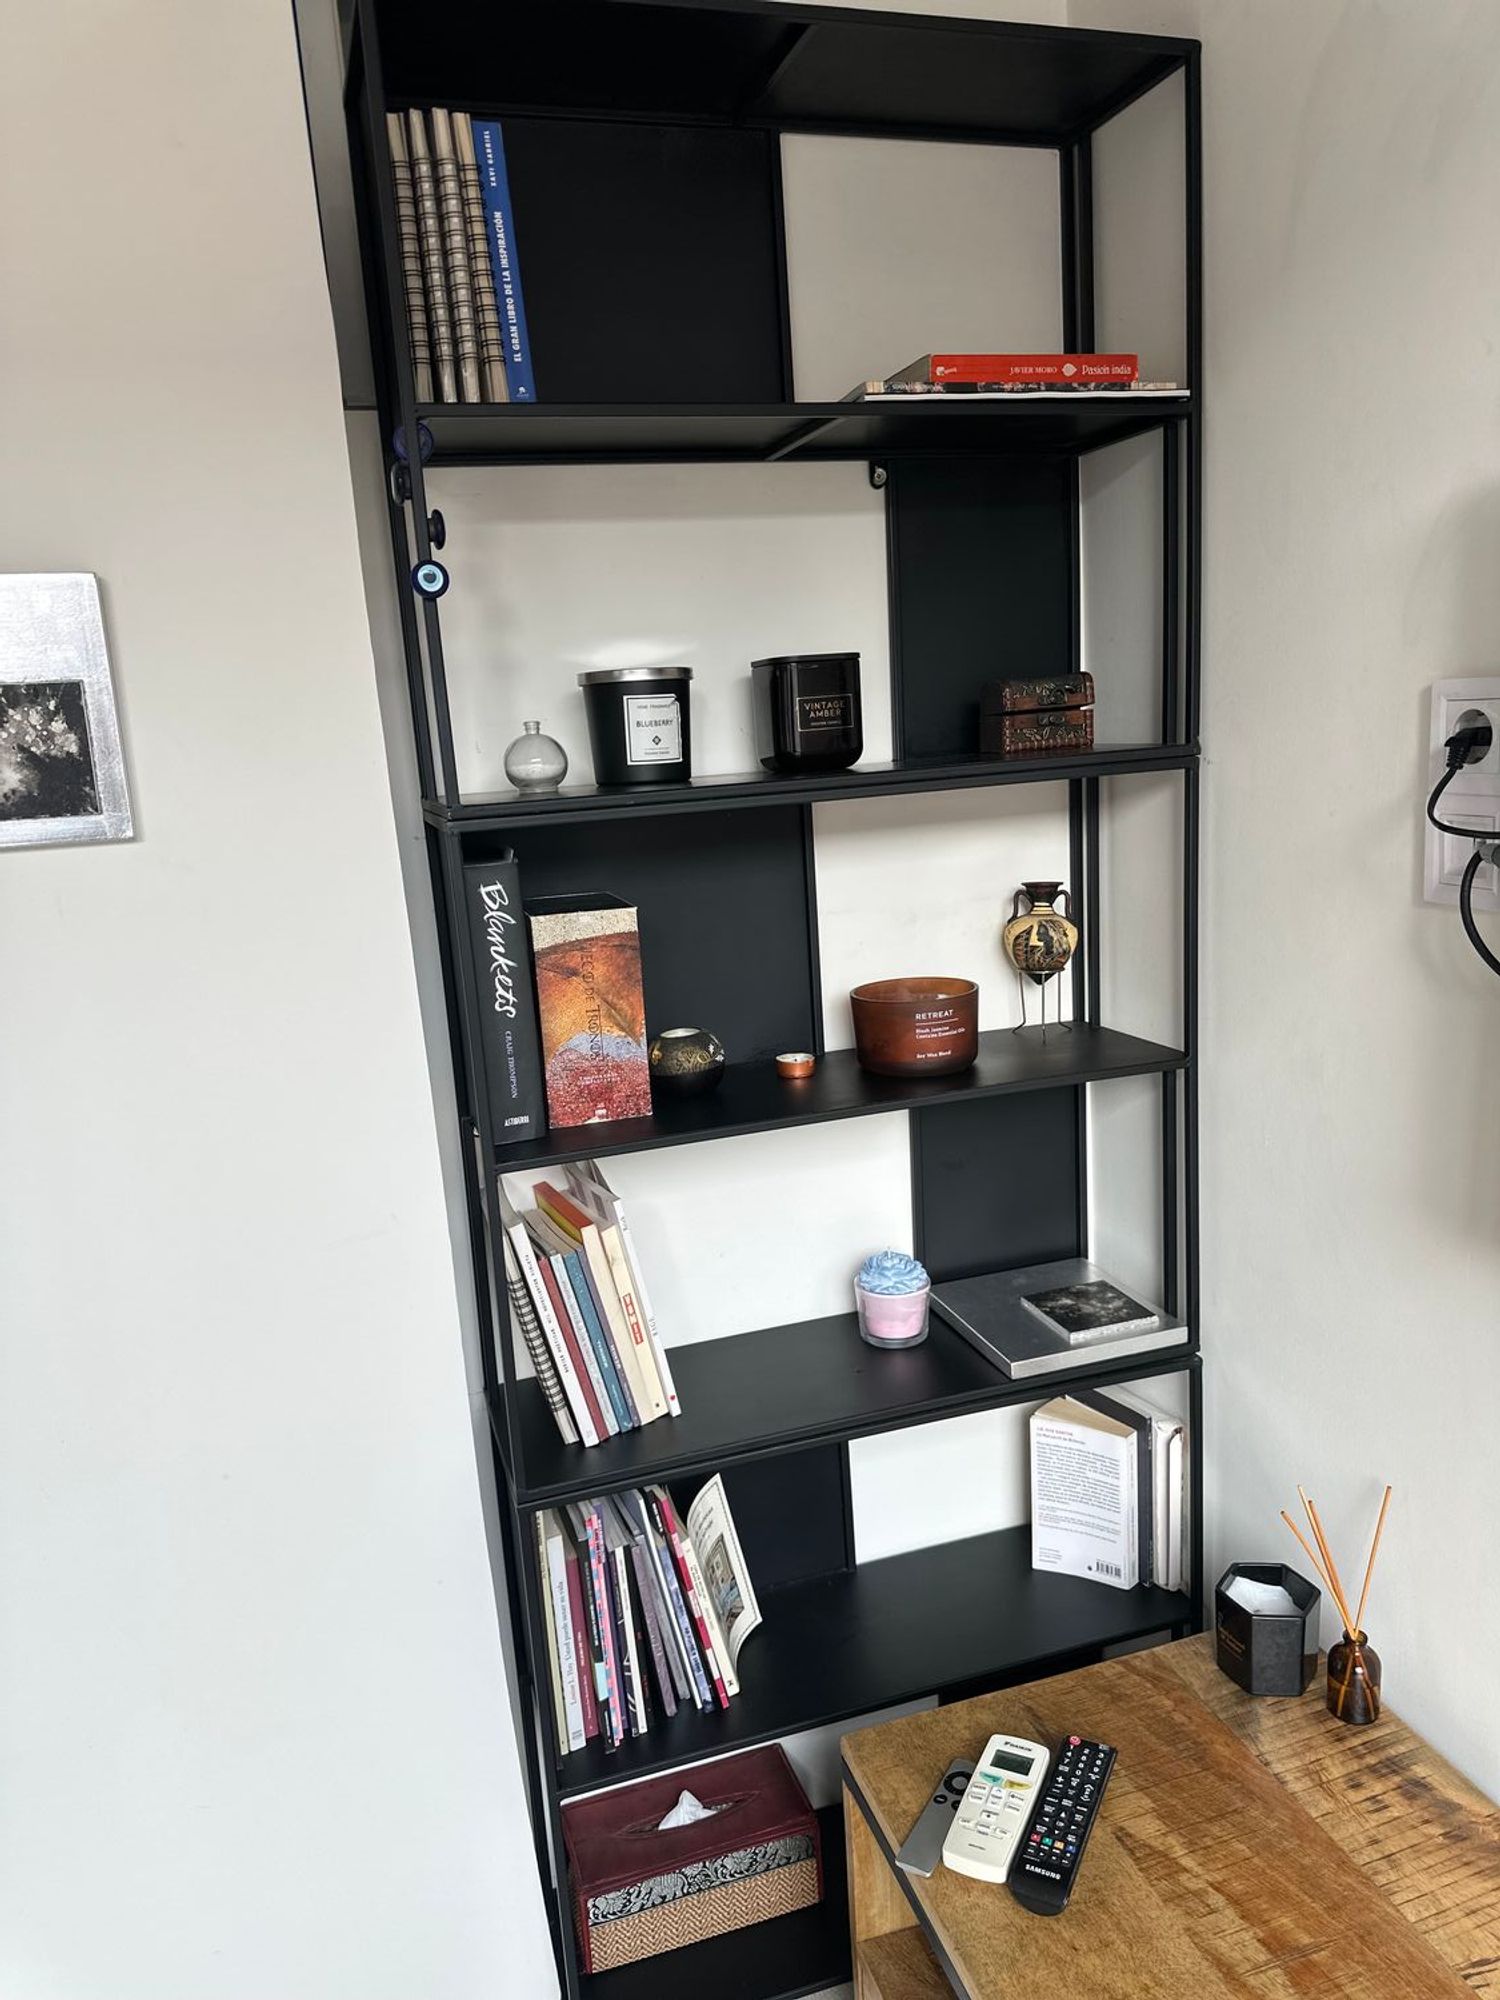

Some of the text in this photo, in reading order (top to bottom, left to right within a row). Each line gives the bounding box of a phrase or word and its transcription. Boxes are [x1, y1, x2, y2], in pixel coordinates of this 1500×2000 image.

[493, 211, 522, 362] EL GRAN LIBRO DE LA INSPIRACIÓN
[803, 700, 845, 711] VINTAGE
[809, 708, 841, 719] AMBER
[636, 719, 674, 728] BLUEBERRY
[478, 880, 518, 1019] Blankets
[584, 988, 595, 1003] DE
[915, 1009, 953, 1020] RETREAT
[505, 1030, 518, 1099] CRAIG THOMPSON
[1025, 1863, 1061, 1880] SAMSUNG
